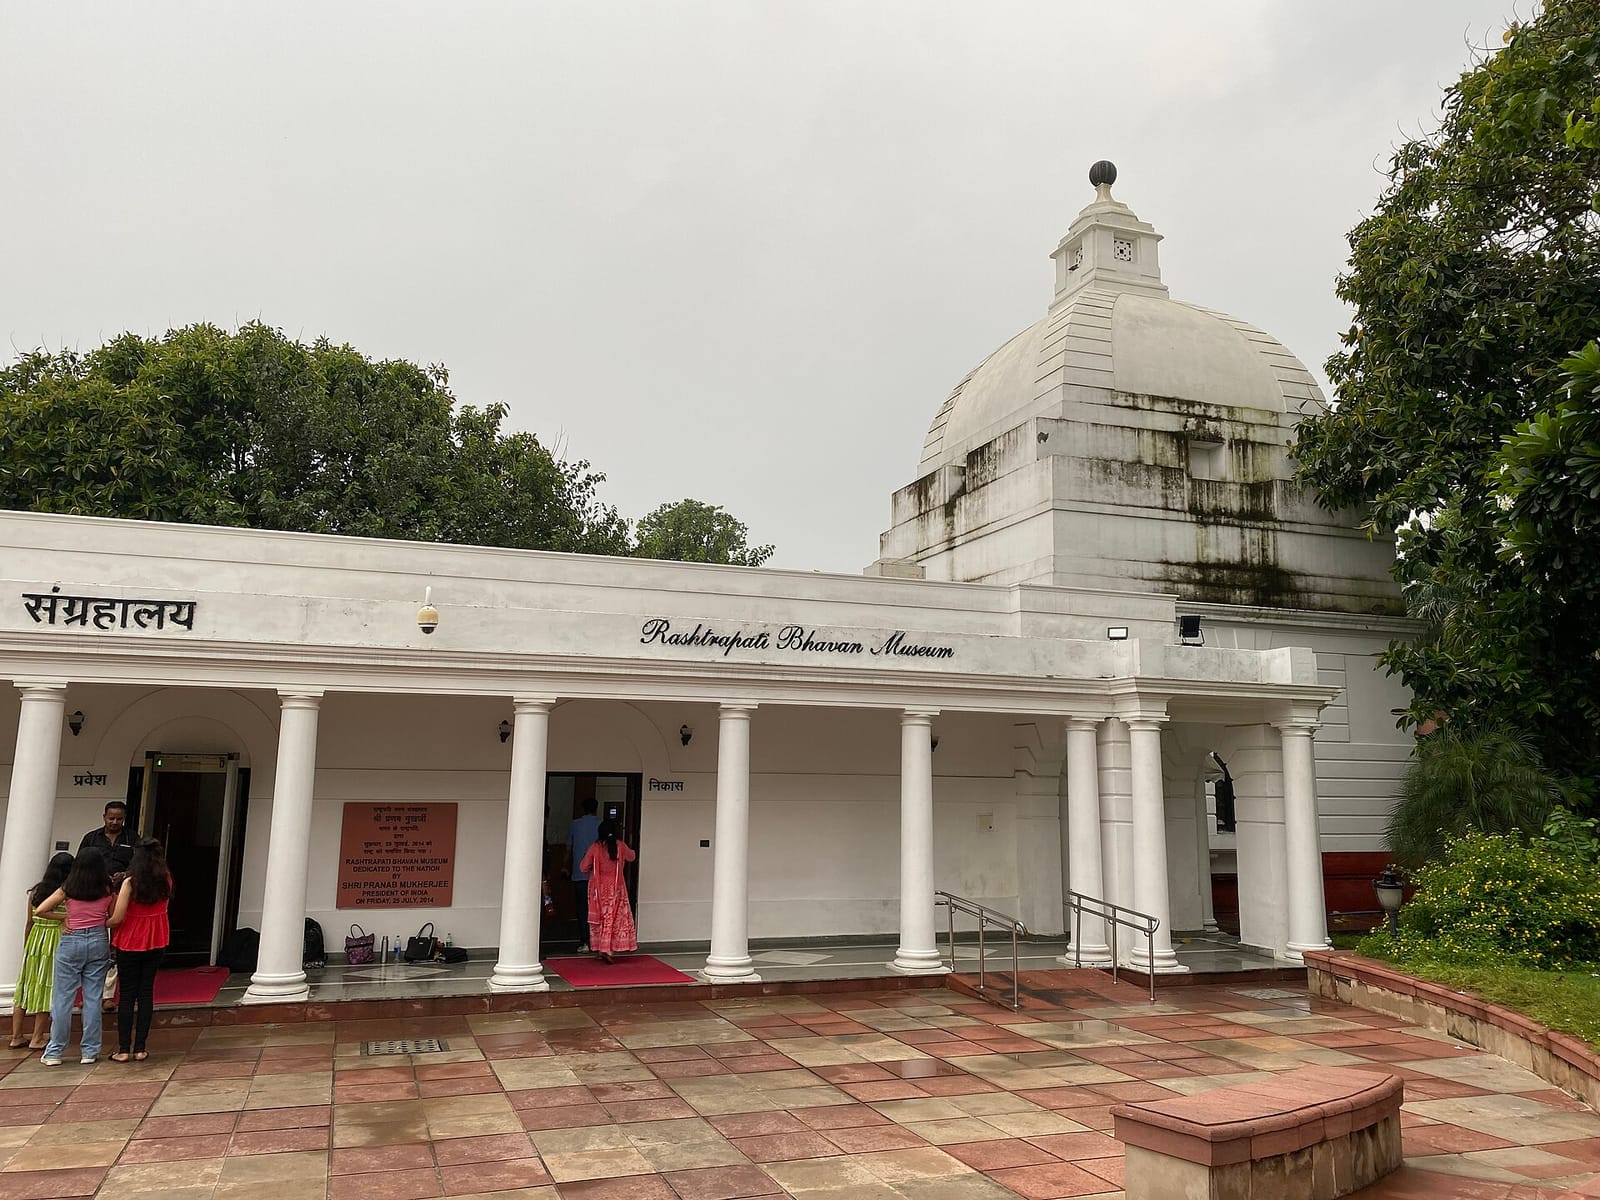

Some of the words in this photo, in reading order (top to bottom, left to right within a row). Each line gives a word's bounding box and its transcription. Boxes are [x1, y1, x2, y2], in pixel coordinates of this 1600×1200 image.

[22, 585, 197, 630] संग्रहालय
[640, 618, 770, 656] Rashtrapati
[777, 625, 863, 654] Bhavan
[870, 630, 955, 660] Museum
[73, 771, 108, 786] प्रवेश
[648, 777, 684, 792] निकास
